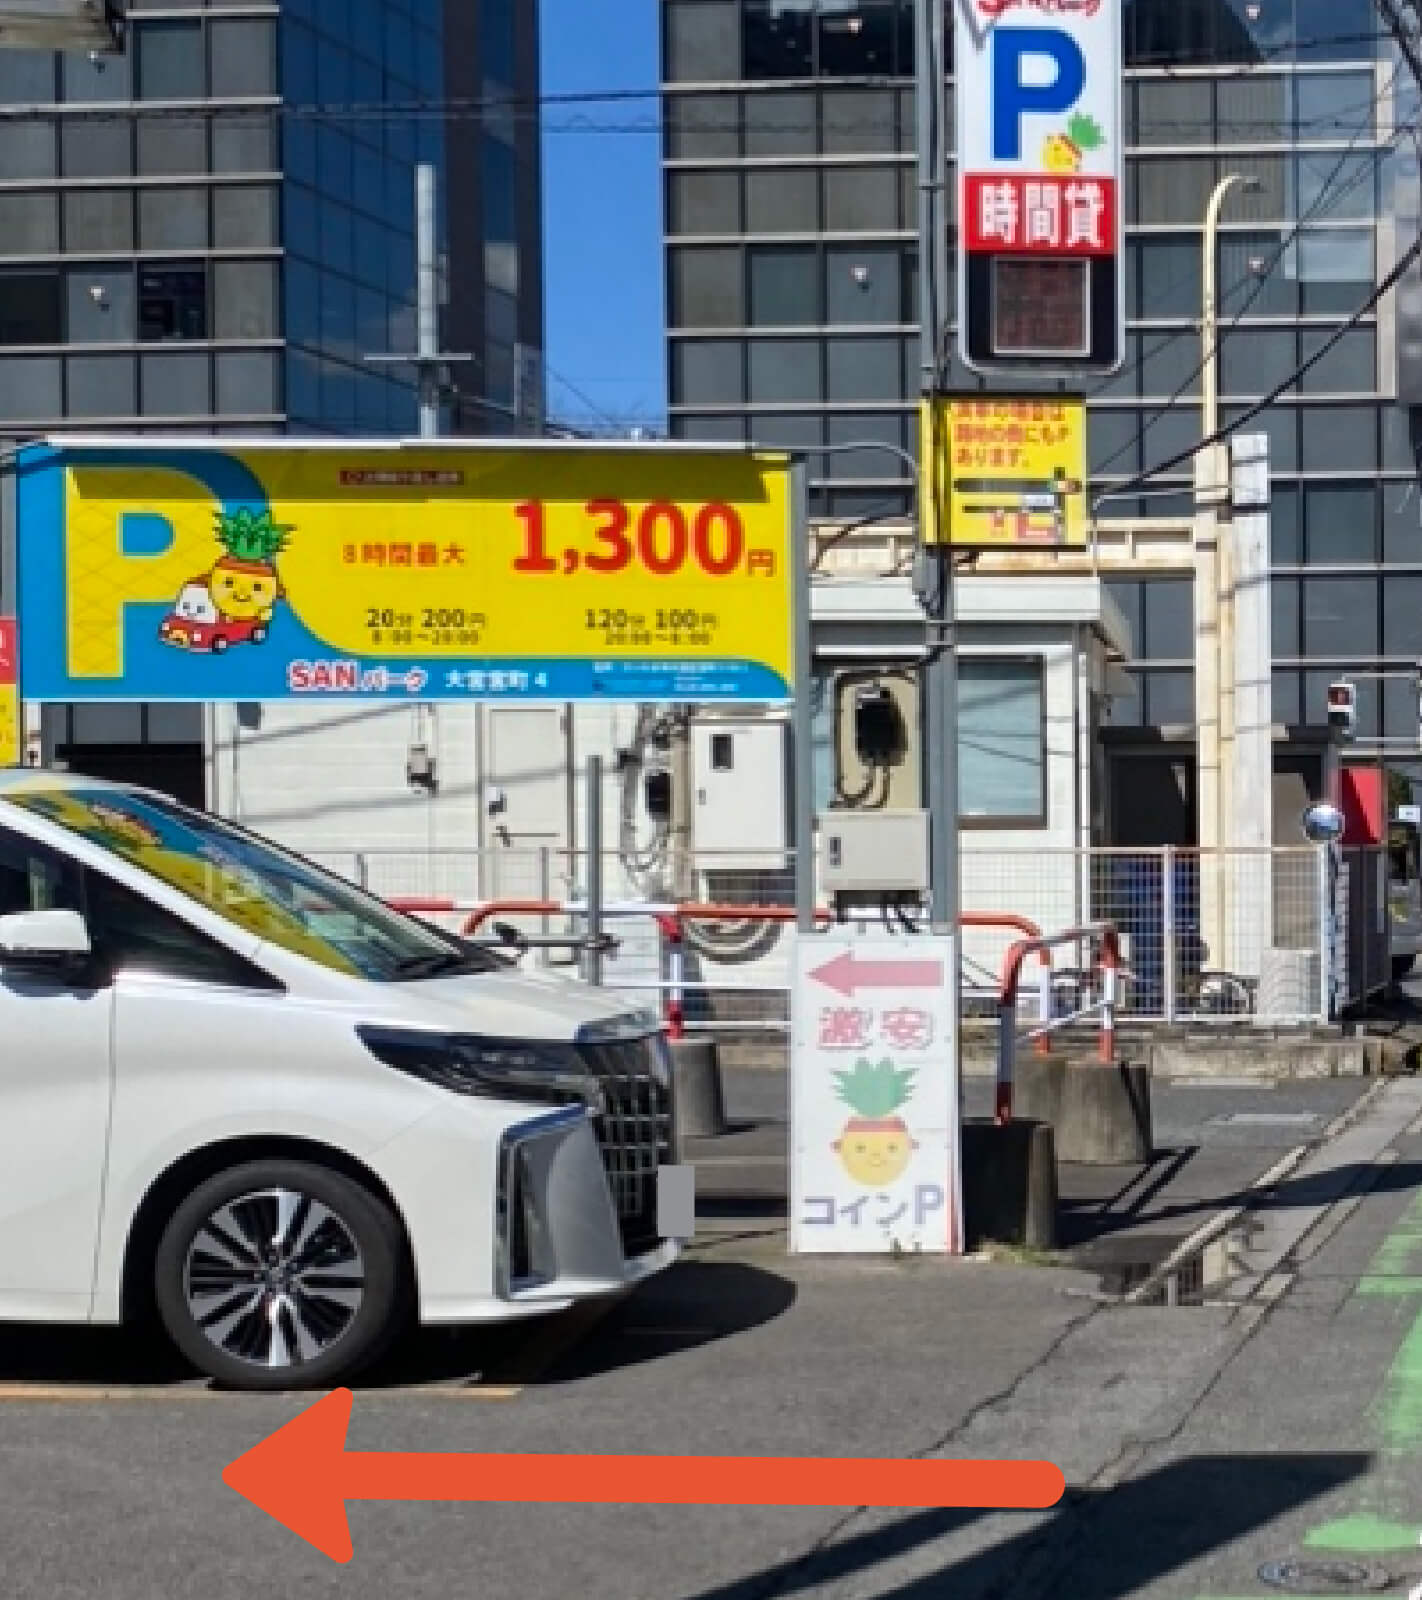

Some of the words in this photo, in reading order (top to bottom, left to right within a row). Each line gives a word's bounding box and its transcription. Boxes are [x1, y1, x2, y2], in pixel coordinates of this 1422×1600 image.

[992, 27, 1086, 160] P
[977, 181, 1104, 246] 時間貸
[65, 465, 227, 678] P
[817, 1006, 933, 1050] 激安
[802, 1184, 944, 1225] コインP
